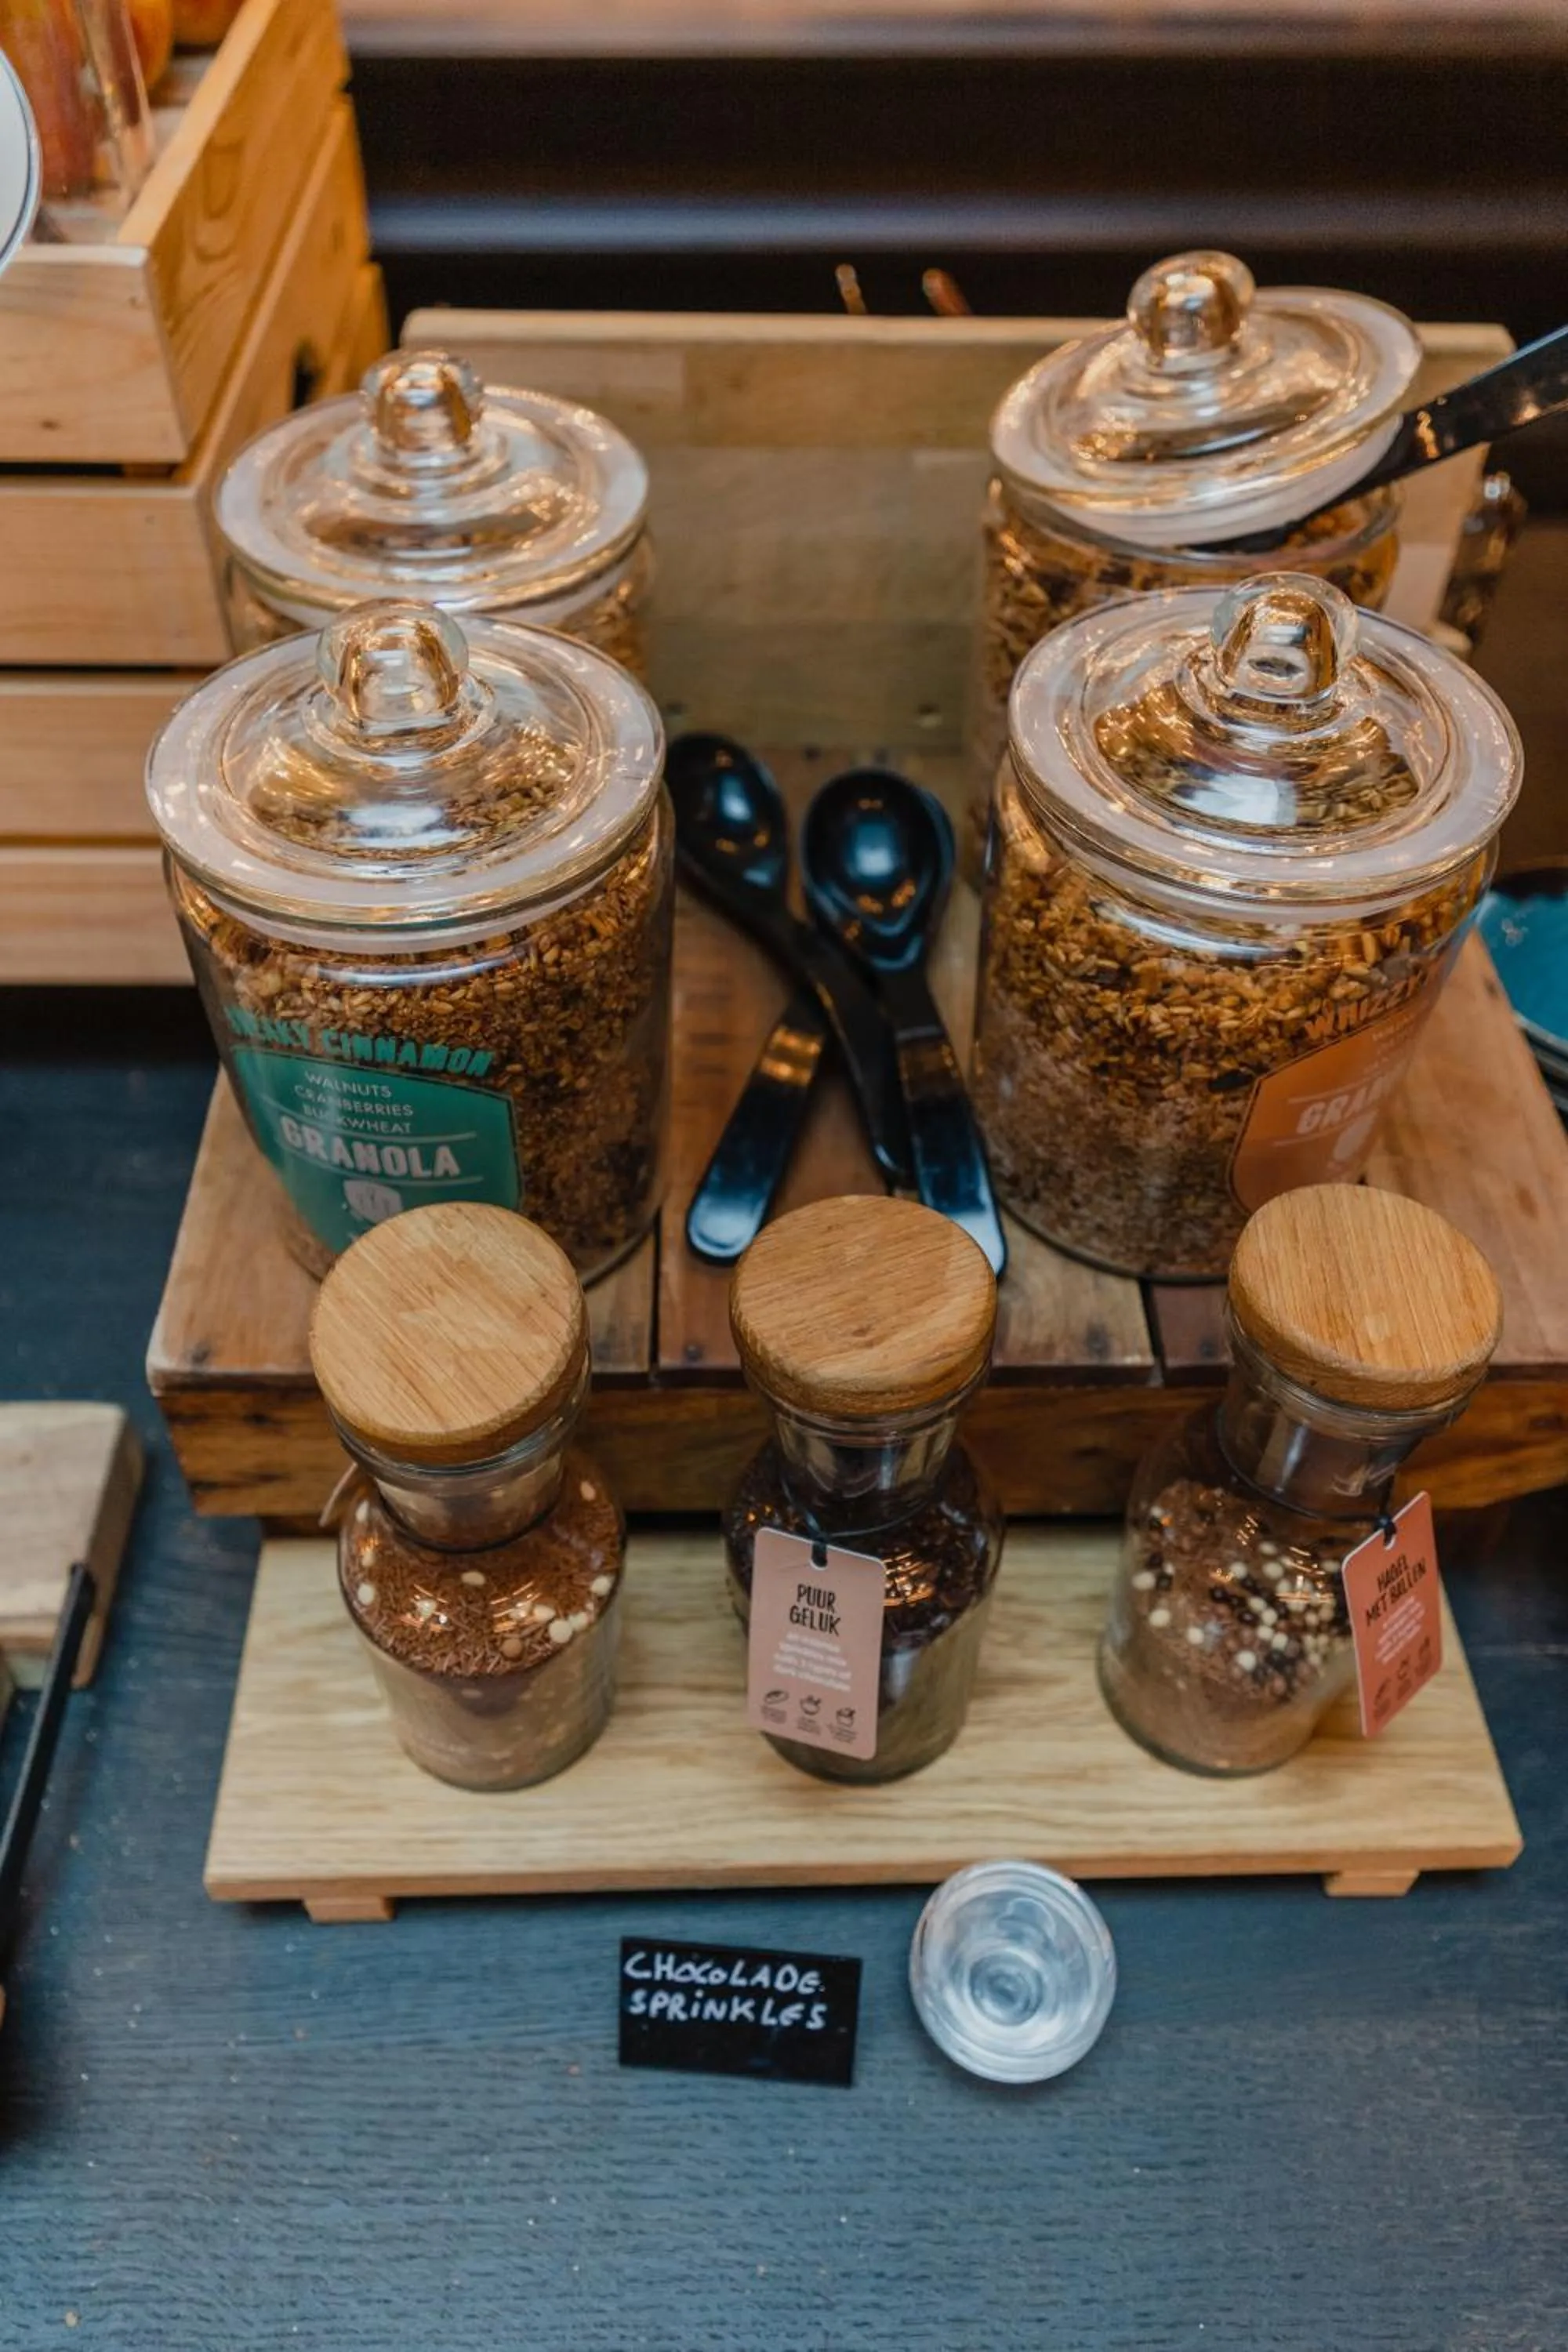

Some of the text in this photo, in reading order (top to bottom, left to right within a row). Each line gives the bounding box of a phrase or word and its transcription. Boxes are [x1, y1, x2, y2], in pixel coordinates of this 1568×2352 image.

[322, 1028, 495, 1077] CINNAMON
[304, 1070, 392, 1098] WALNUTS
[303, 1102, 412, 1134] BUKWHEAT
[280, 1116, 461, 1178] GRANOLA
[797, 1584, 837, 1613] PUUR
[789, 1605, 841, 1637] GELUK
[623, 1951, 821, 1995] CHOCOLADE
